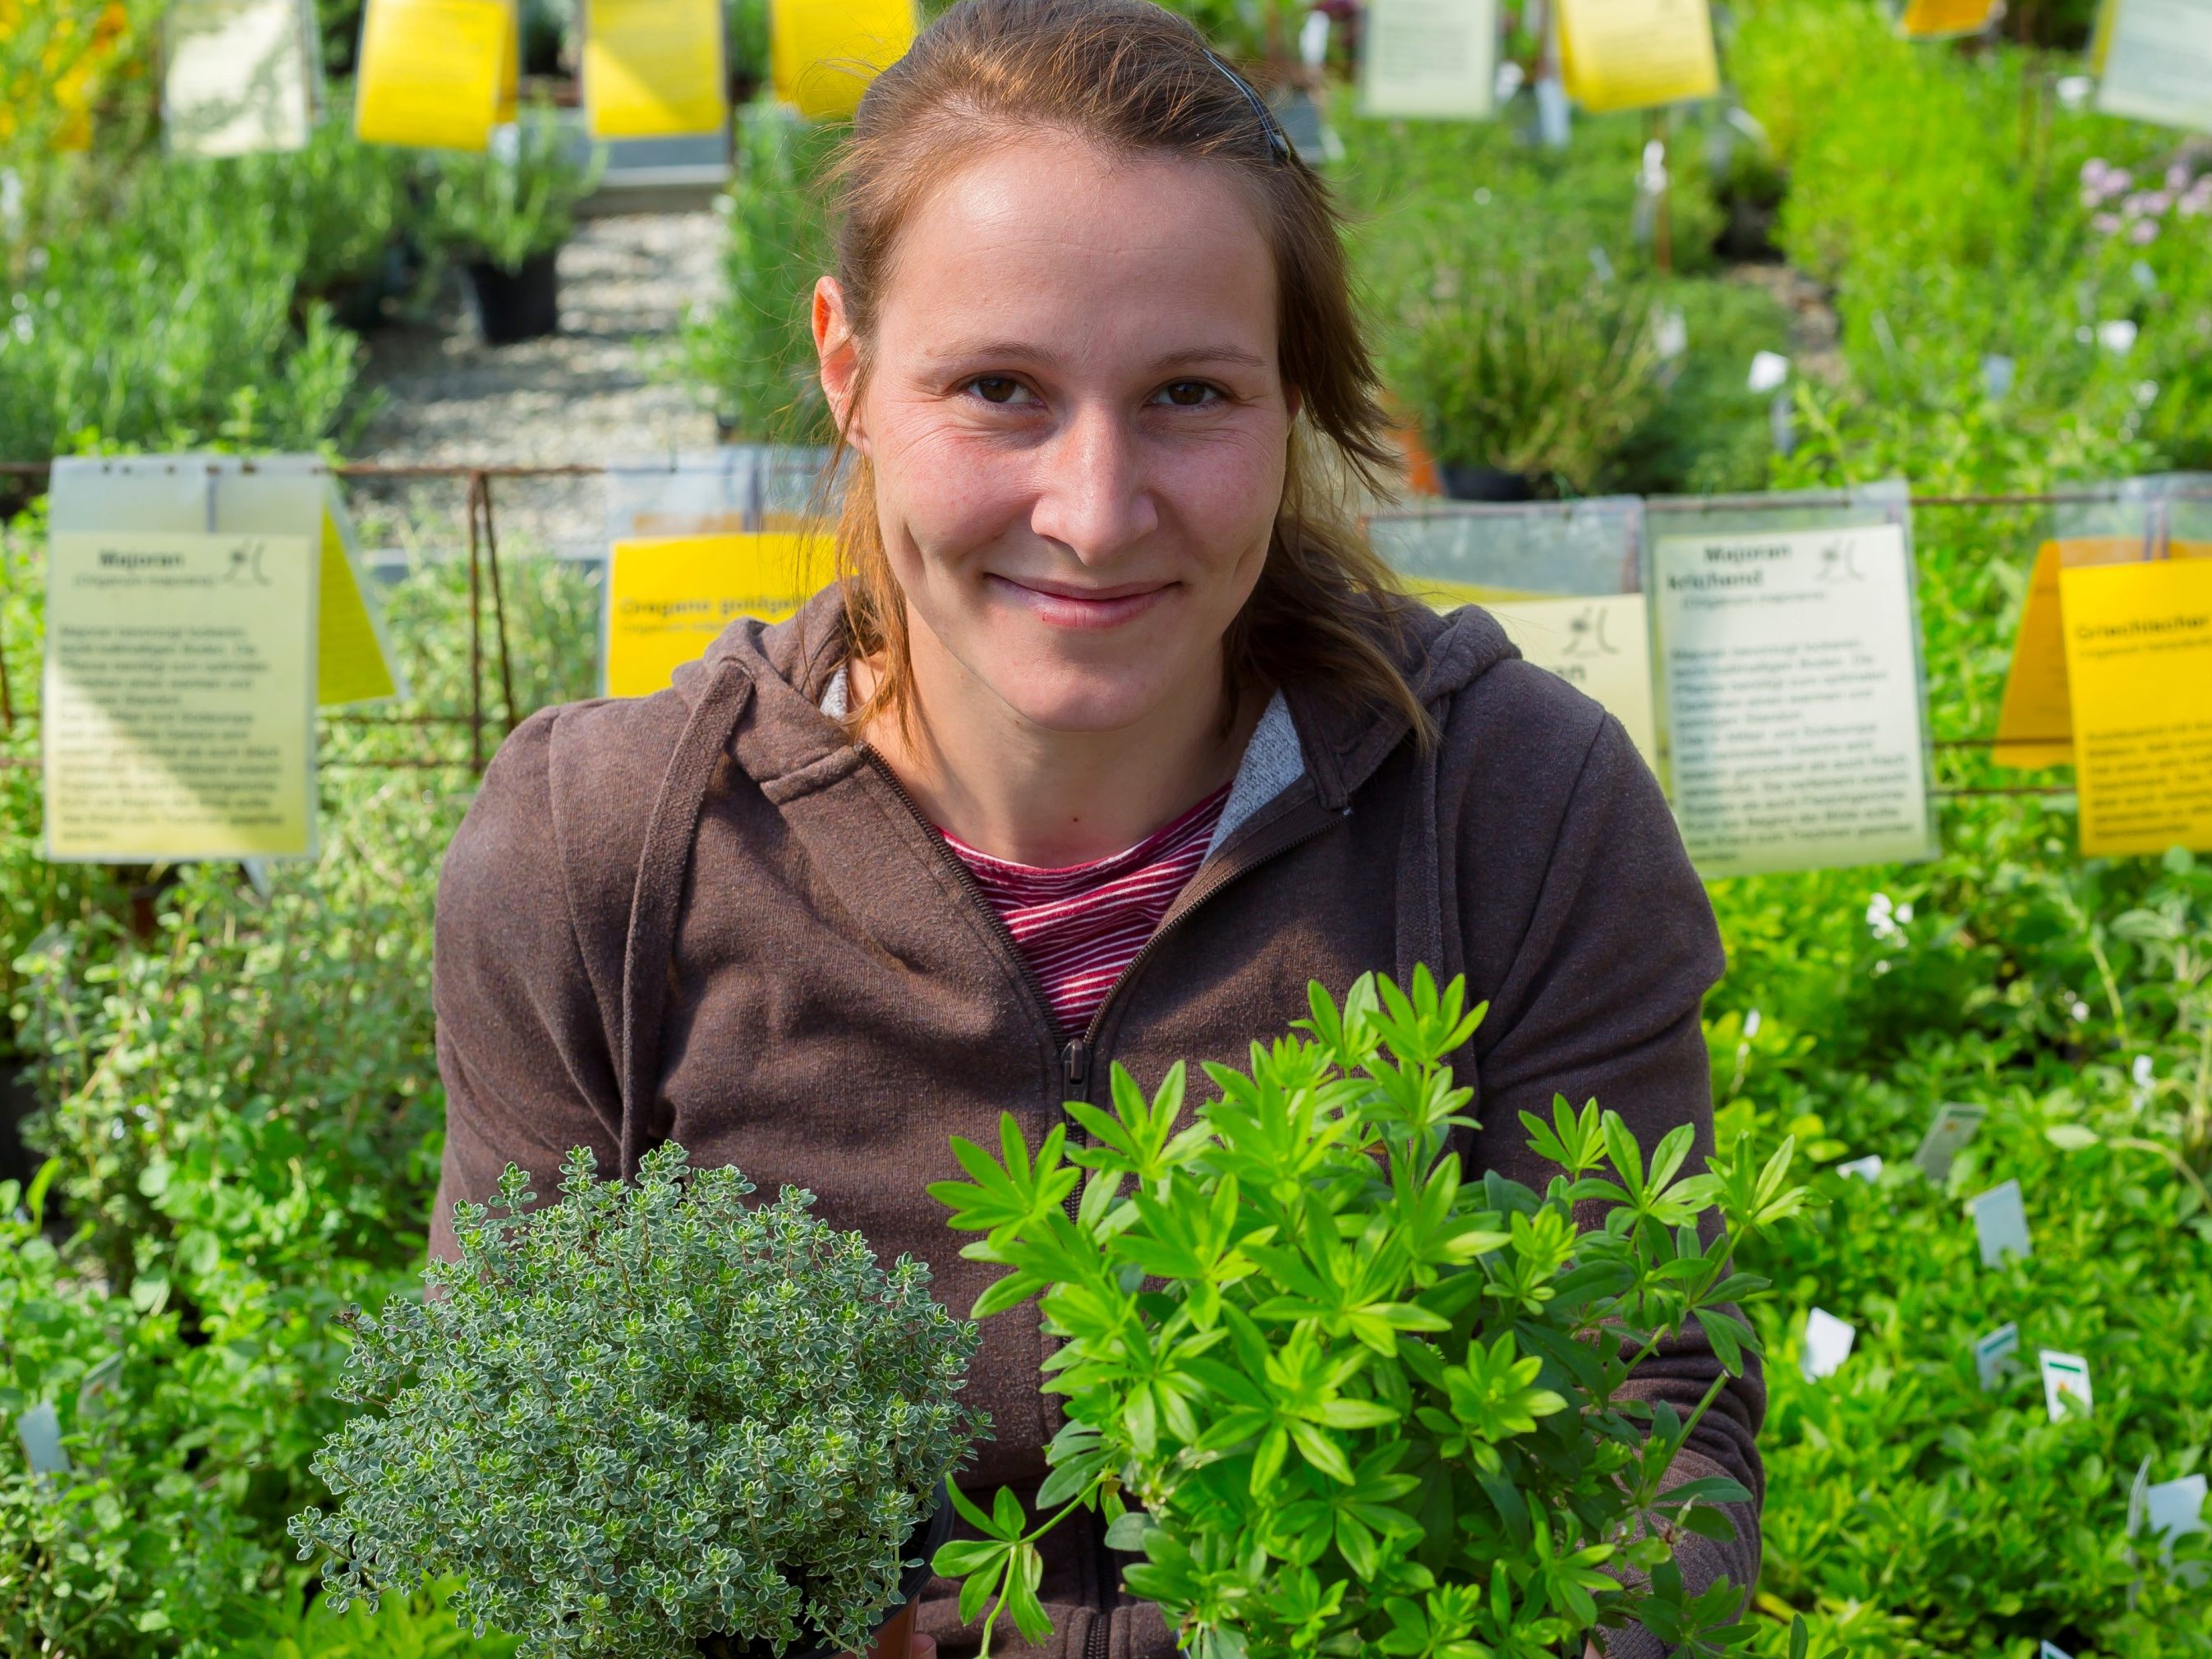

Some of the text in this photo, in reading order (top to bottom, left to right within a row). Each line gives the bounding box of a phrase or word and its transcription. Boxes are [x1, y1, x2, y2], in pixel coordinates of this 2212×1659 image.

[99, 549, 184, 572] Majoran
[1705, 544, 1791, 566] Majoran
[620, 596, 711, 617] Oregano
